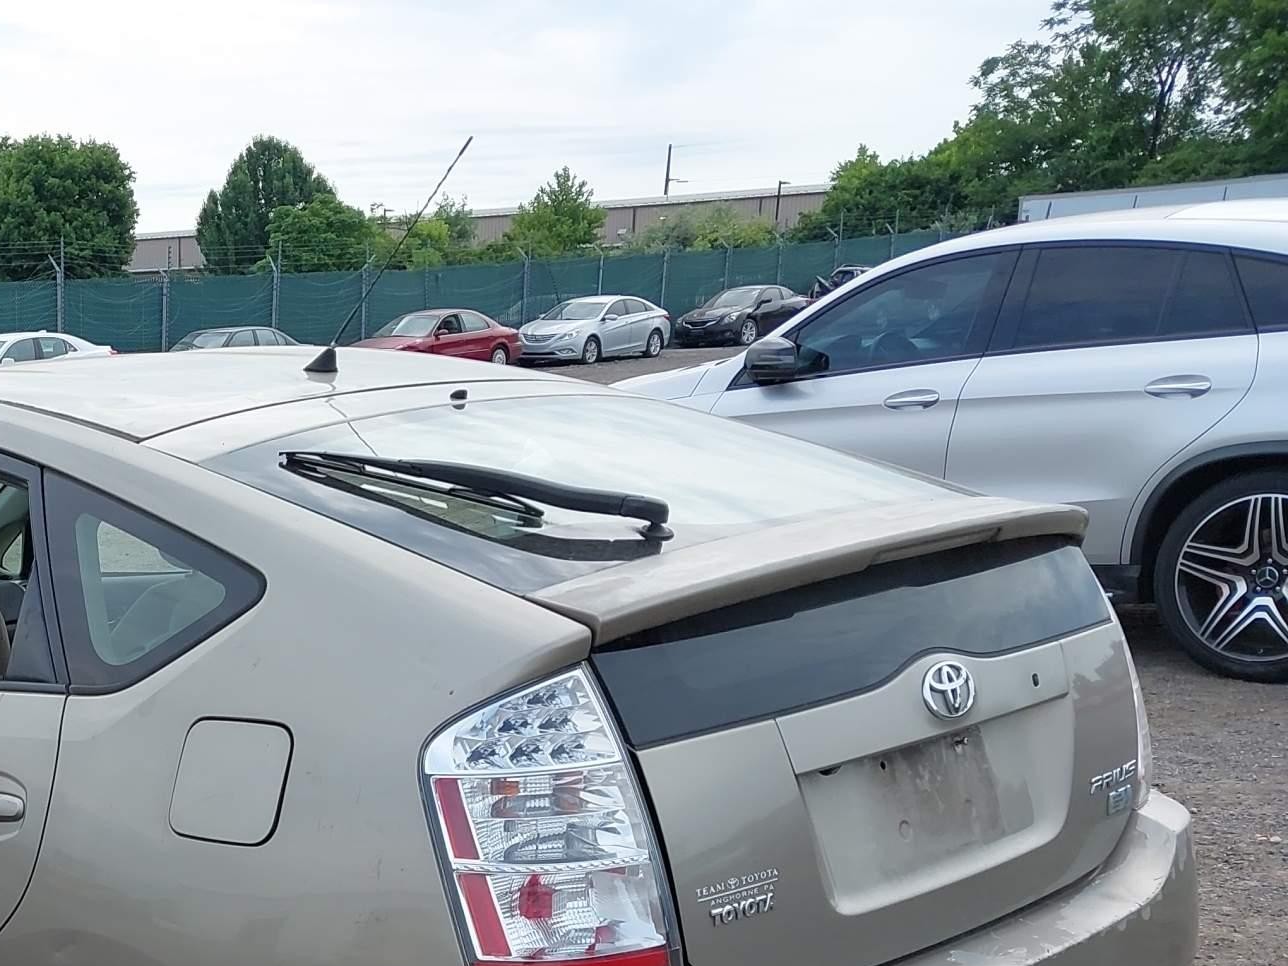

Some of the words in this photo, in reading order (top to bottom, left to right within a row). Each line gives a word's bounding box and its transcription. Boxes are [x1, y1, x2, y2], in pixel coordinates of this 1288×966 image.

[1090, 759, 1136, 795] PRIUS
[695, 881, 725, 897] TEAM
[741, 867, 779, 885] TOYOTA
[710, 892, 774, 926] TOYOTA
